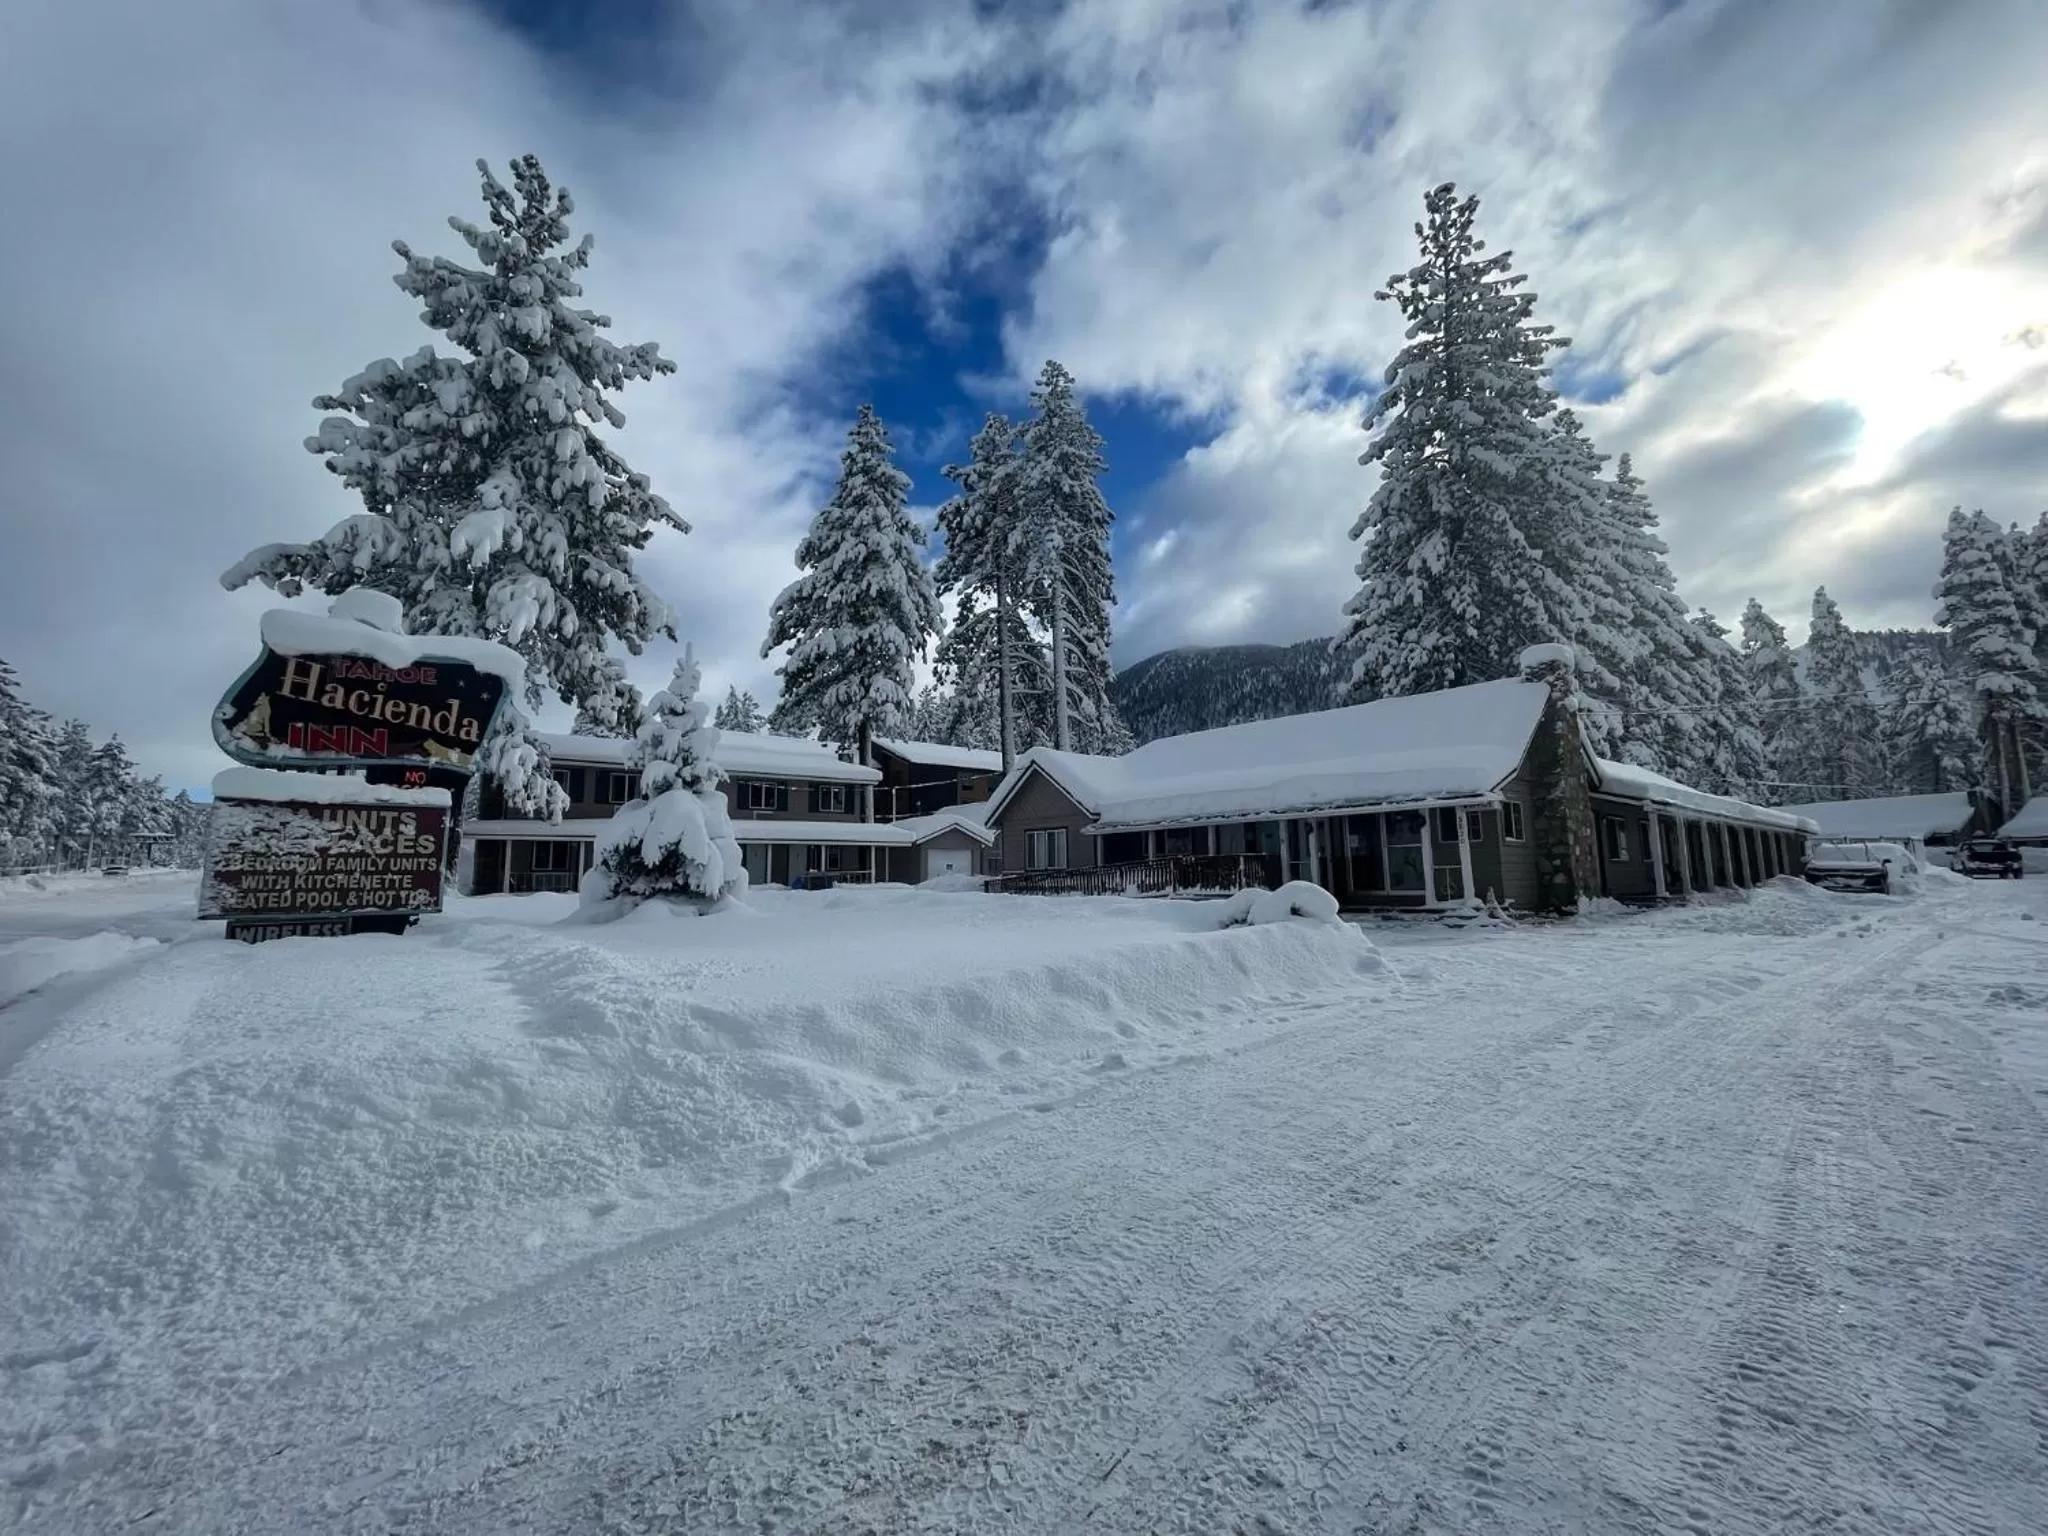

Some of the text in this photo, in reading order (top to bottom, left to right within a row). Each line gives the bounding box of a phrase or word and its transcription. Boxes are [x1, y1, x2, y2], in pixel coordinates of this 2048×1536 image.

[332, 659, 437, 685] TAHOE
[276, 656, 480, 742] Hacienda
[288, 722, 388, 757] INN
[404, 770, 426, 785] NO
[322, 808, 417, 836] UNITS
[326, 858, 386, 871] FAMILY
[390, 858, 438, 871] UNITS
[241, 874, 413, 889] WITH KITCHENETTE
[230, 891, 292, 909] EATED
[296, 891, 342, 907] POOL
[346, 891, 358, 906] &
[362, 890, 397, 907] HOT
[235, 924, 343, 943] WIRELESS
